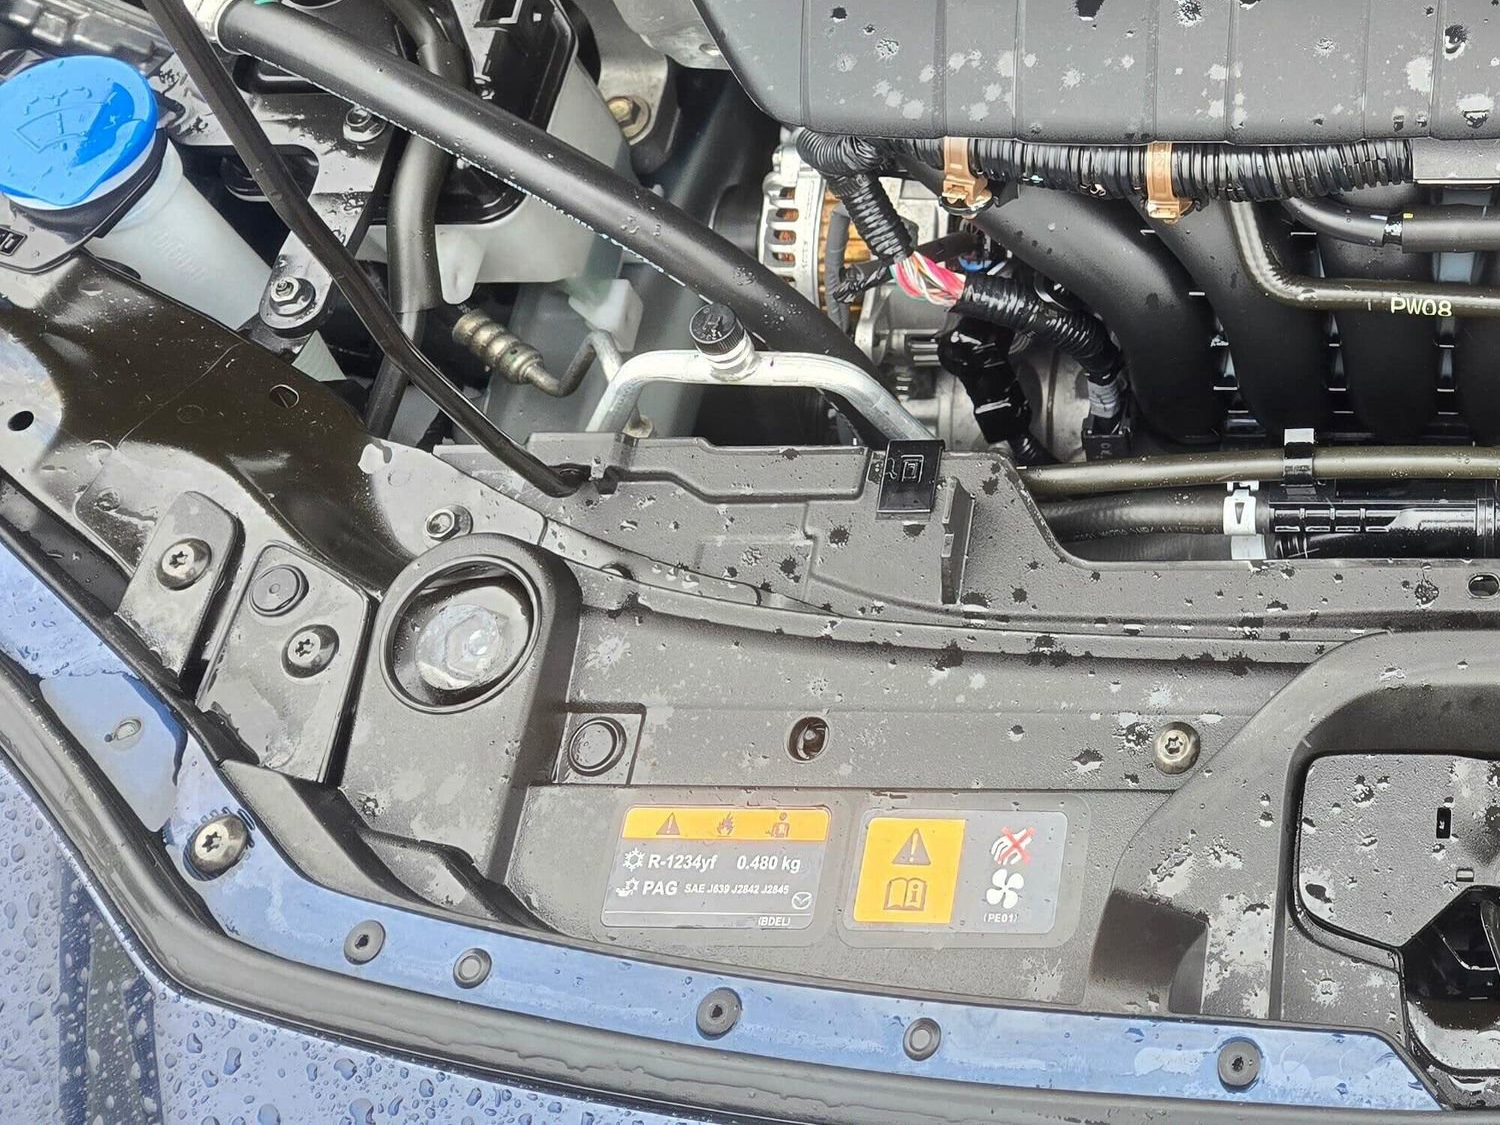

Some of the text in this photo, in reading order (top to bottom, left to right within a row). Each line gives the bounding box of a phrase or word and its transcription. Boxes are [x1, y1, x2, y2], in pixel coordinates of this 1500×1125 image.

[1390, 296, 1453, 317] PW08
[648, 854, 801, 874] R-1234yf 0.480 kg
[642, 880, 789, 896] PAG SAE J639 J2842 J2845
